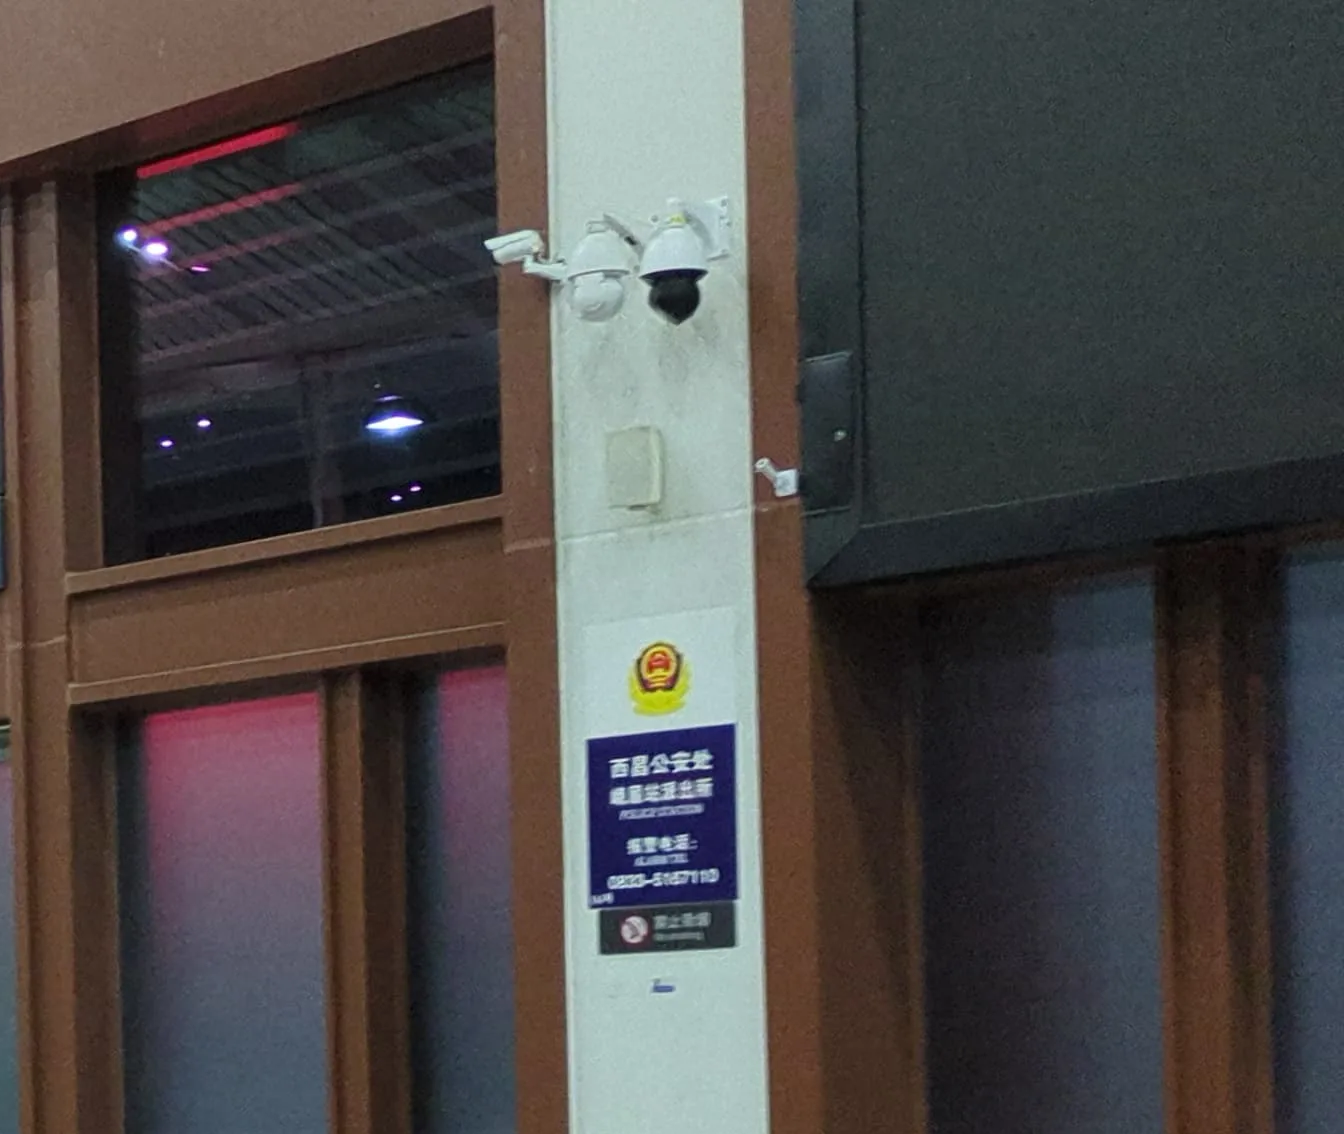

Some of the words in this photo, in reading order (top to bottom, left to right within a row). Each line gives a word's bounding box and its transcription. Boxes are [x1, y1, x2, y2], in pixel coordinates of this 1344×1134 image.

[608, 749, 714, 779] 西昌公安处
